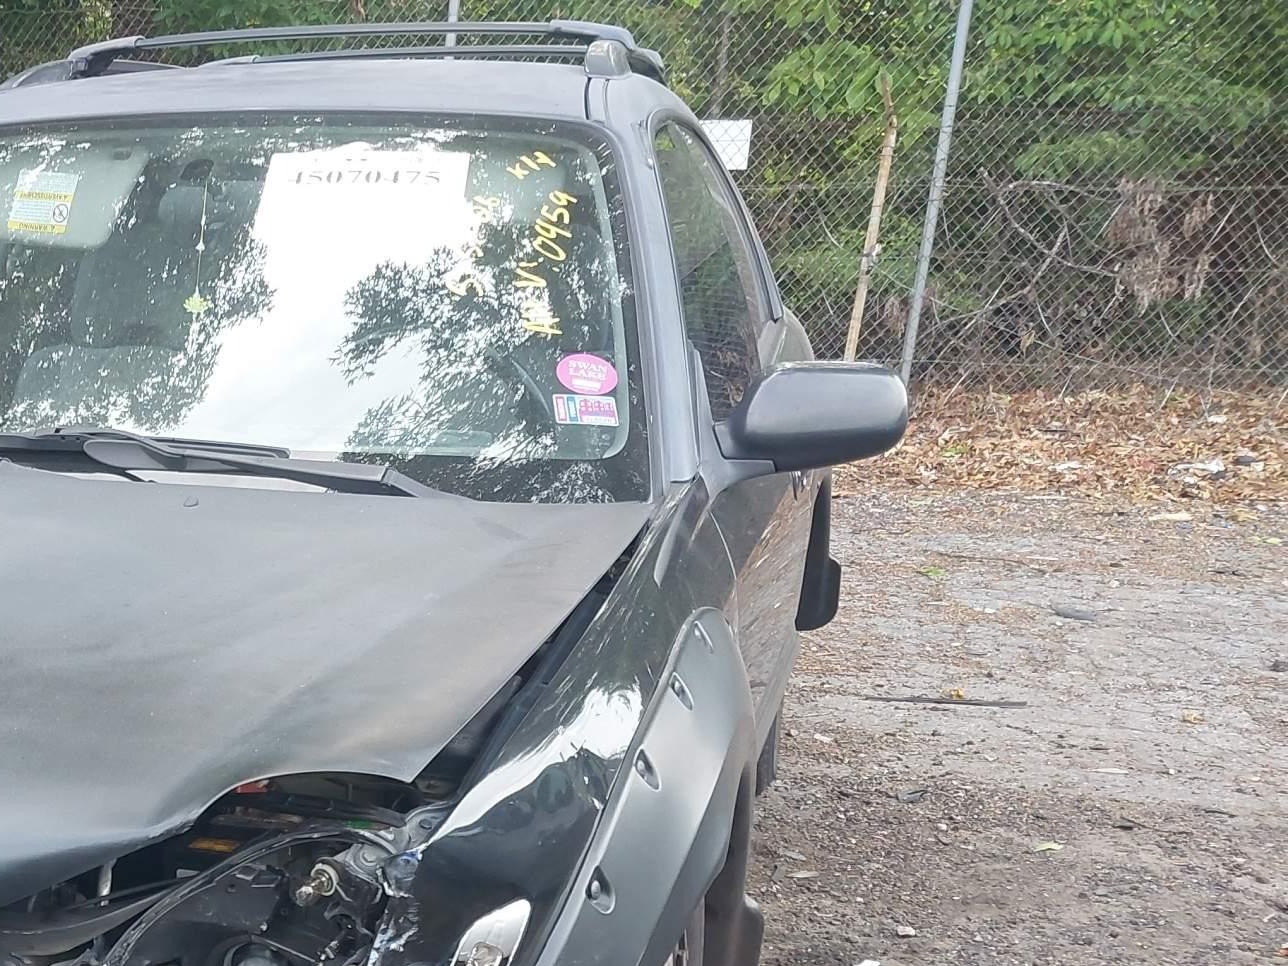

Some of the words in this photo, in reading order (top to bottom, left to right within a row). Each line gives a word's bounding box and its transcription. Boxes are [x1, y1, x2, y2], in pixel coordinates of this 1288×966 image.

[532, 190, 578, 261] 0459
[567, 360, 609, 376] SWAN
[568, 367, 608, 382] LAKE
